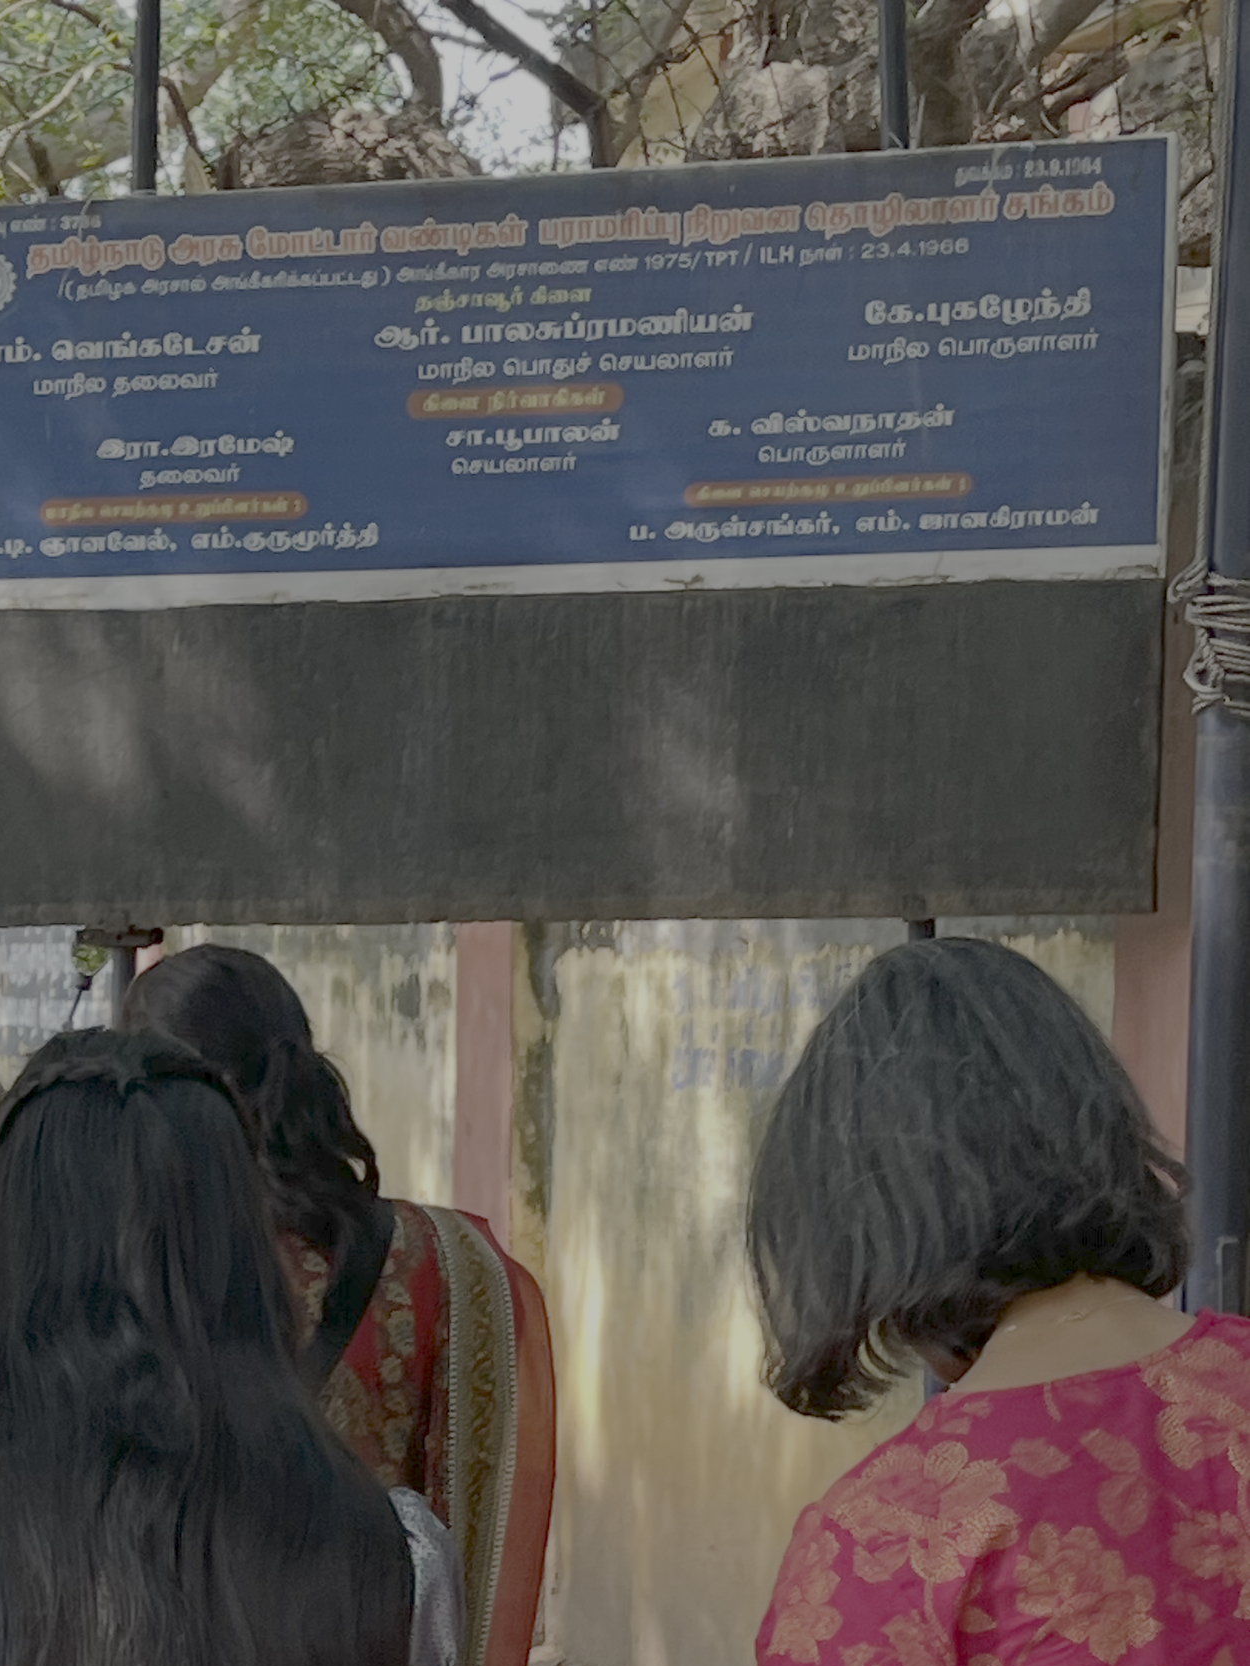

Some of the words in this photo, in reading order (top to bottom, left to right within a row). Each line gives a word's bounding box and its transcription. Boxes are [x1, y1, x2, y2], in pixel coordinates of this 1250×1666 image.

[26, 234, 166, 279] தமிழ்நாடு
[167, 233, 243, 266] அரசு
[245, 221, 379, 260] மோட்டார்
[380, 213, 528, 256] வண்டிகள்
[538, 205, 681, 249] பராமரிப்பு
[682, 203, 801, 247] நிறுவன
[804, 188, 1000, 240] தொழிலாளர்
[1003, 181, 1115, 221] சங்கம்
[704, 250, 739, 268] TPT
[799, 243, 843, 267] நாள்
[413, 285, 523, 314] தஞ்சாவூர்
[529, 284, 592, 306] கிளை
[374, 317, 450, 350] ஆர்.
[461, 303, 754, 345] பாலசுப்ரமணியன்
[51, 326, 261, 362] வெங்கடேசன்
[847, 336, 930, 366] மாநில
[938, 327, 1100, 359] பொருளாளர்
[418, 356, 496, 385] மாநில
[503, 351, 592, 380] பொதுச்
[598, 346, 734, 372] செயலாளர்
[33, 371, 107, 400] மாநில
[112, 367, 219, 397] தலைவர்
[445, 417, 621, 451] சா.பூபாலன்
[708, 416, 742, 437] க.
[750, 403, 956, 435] விஸ்வநாதன்
[450, 451, 577, 475] செயலாளர்
[757, 438, 908, 466] பொருளாளர்
[138, 463, 241, 490] தலைவர்
[855, 508, 911, 533] எம்.
[918, 501, 1100, 531] ஜானகிராமன்
